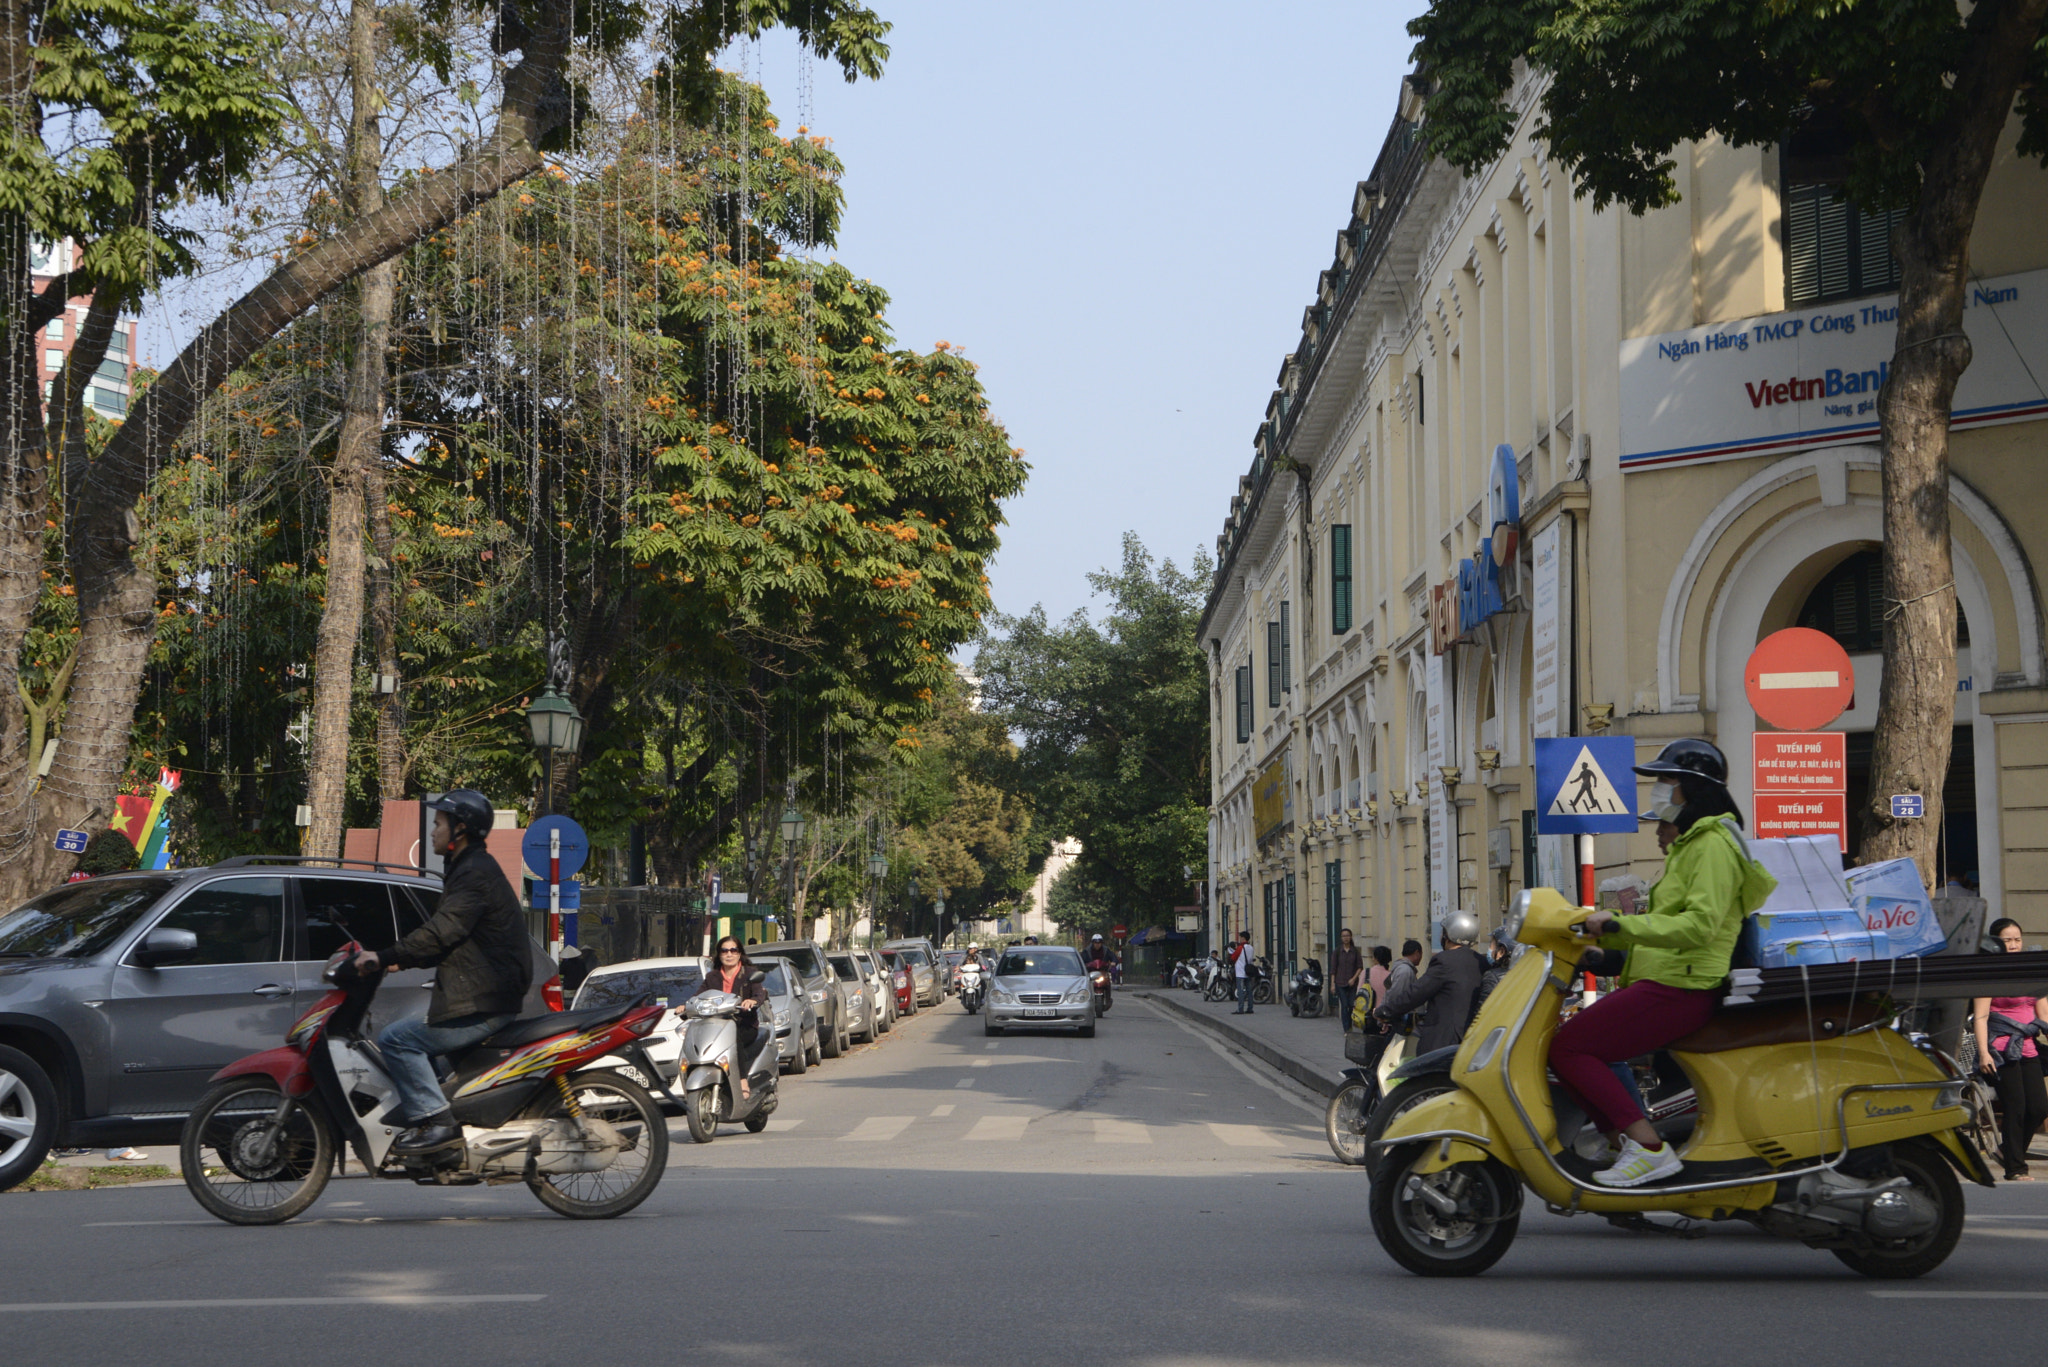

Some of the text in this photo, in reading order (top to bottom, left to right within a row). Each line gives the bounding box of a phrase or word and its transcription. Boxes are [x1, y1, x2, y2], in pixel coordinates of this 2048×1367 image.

[1658, 339, 1700, 362] Ngân
[1706, 331, 1749, 351] Hàng
[1753, 319, 1804, 343] TMCP
[1810, 314, 1856, 333] Công
[1974, 287, 2018, 307] Nam
[1776, 741, 1822, 754] TUYẾN PHỐ
[1779, 760, 1786, 768] XE
[1800, 760, 1806, 768] XE
[1777, 802, 1823, 814] TUYẾN PHỐ
[1900, 807, 1914, 815] 28
[1760, 820, 1782, 829] KHÔNG
[1801, 821, 1817, 829] KINH
[1818, 821, 1840, 829] DOANH
[63, 841, 77, 850] 30
